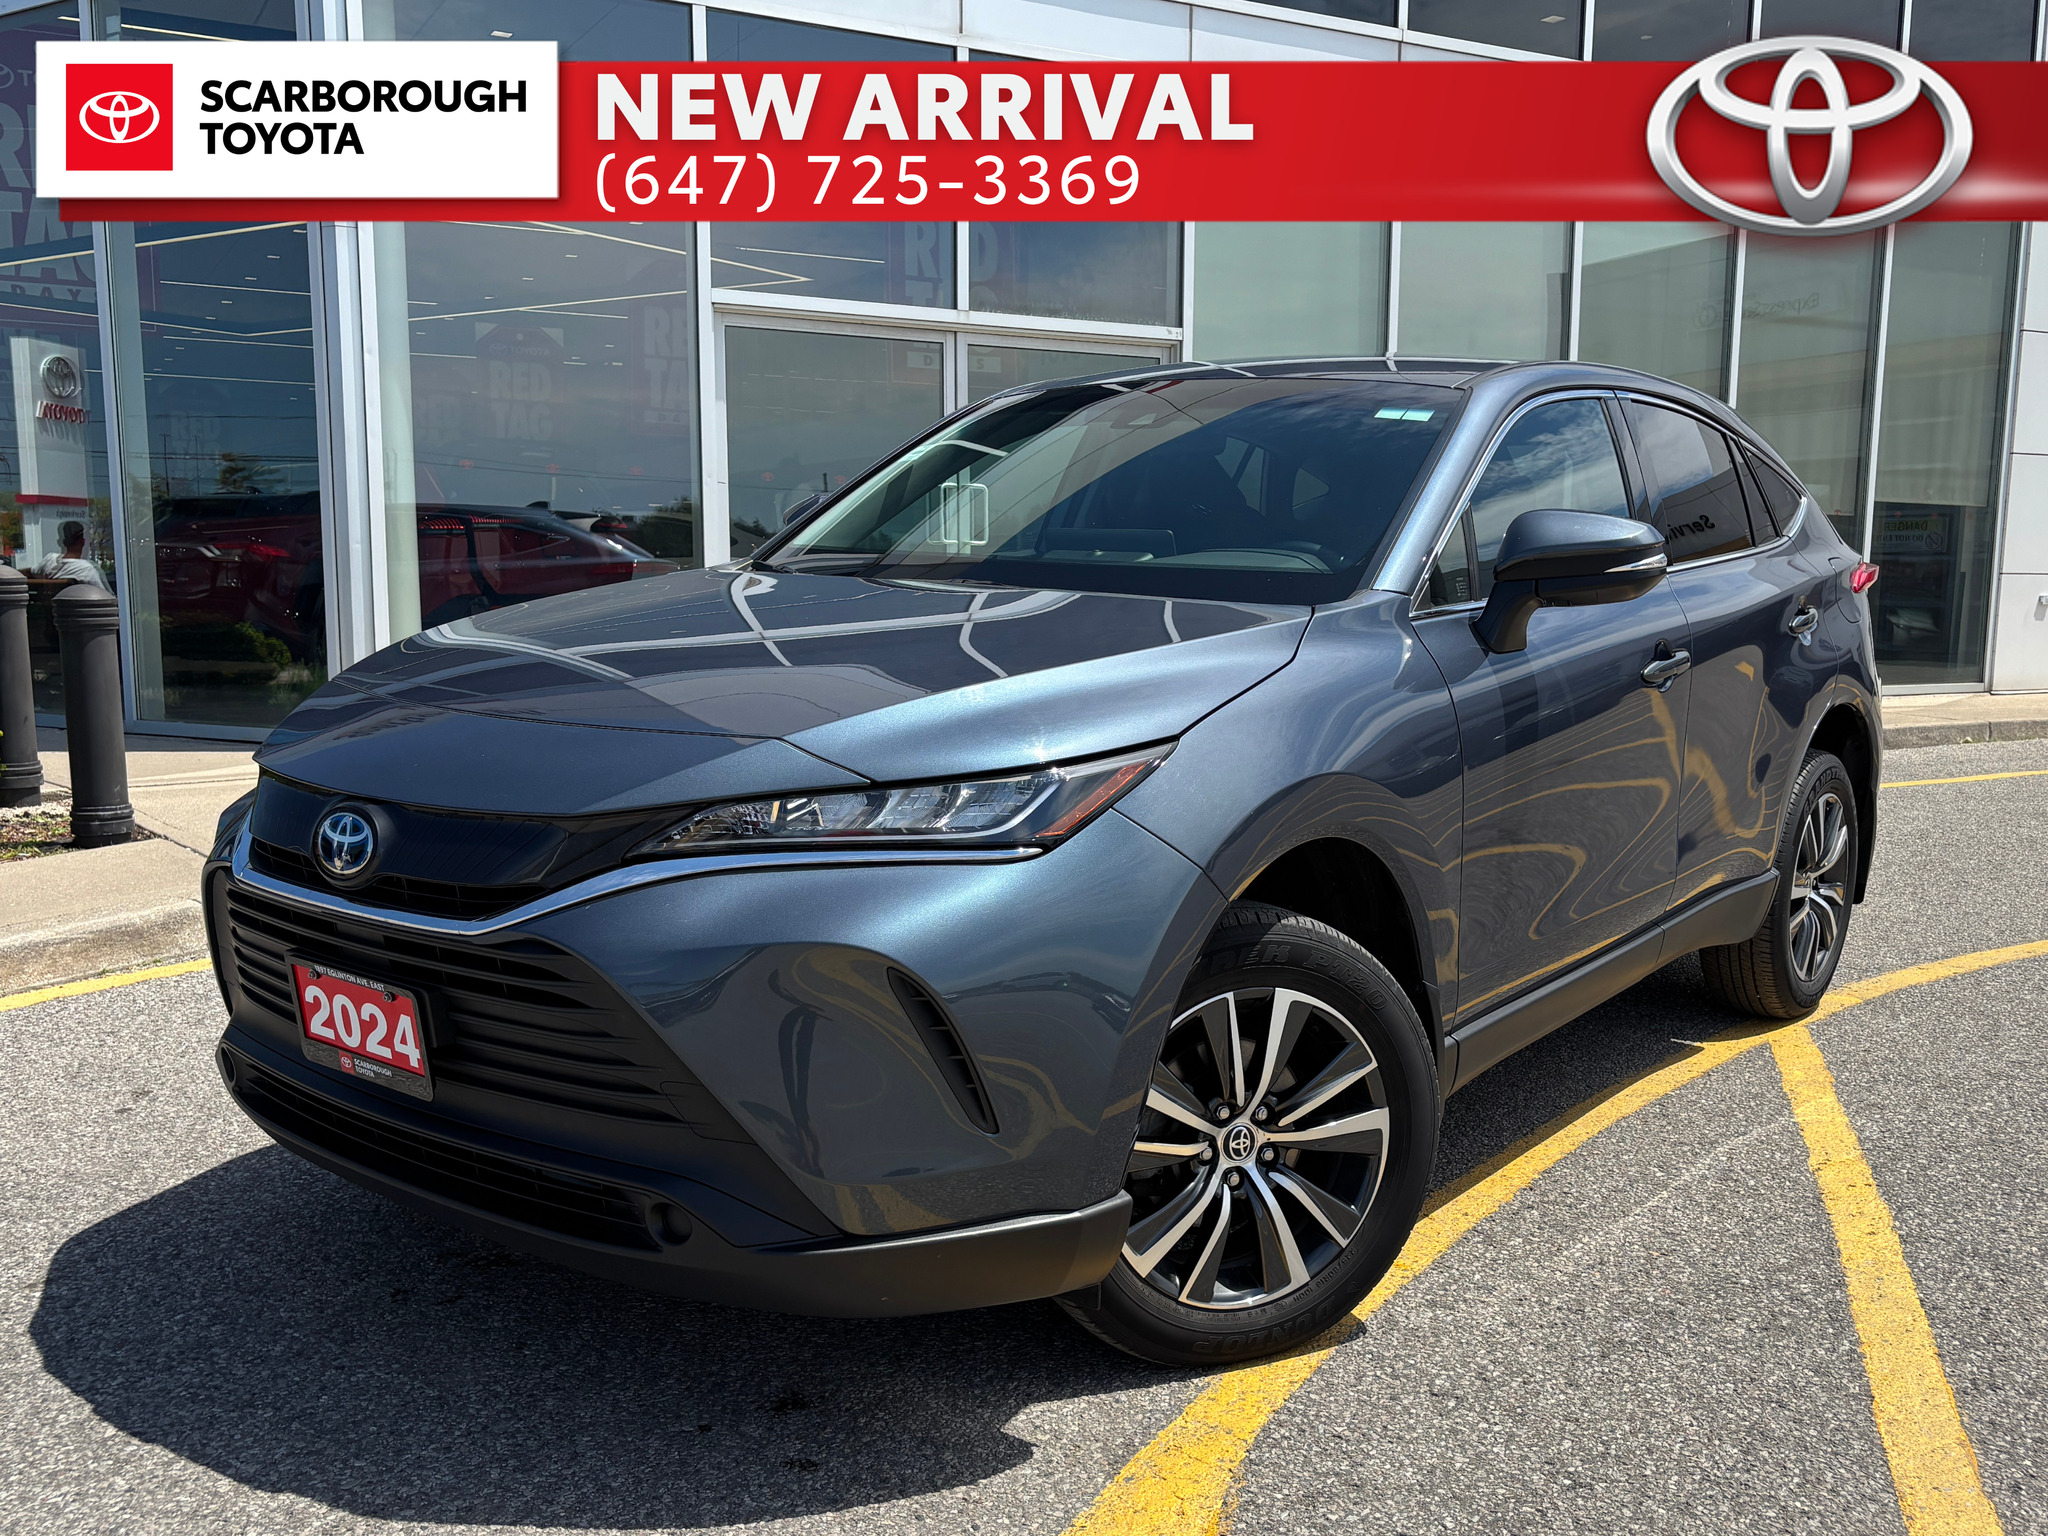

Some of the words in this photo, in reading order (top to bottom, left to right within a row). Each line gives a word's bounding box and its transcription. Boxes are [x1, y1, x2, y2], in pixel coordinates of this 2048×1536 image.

[489, 360, 552, 402] RED
[490, 401, 554, 441] TAG
[327, 968, 357, 984] EGLINTON
[370, 981, 385, 992] EAST
[304, 984, 421, 1069] 2024
[354, 1058, 393, 1077] SCARBOROUGH
[355, 1066, 375, 1078] TOYOTA
[1191, 1295, 1337, 1353] DUNLOP
